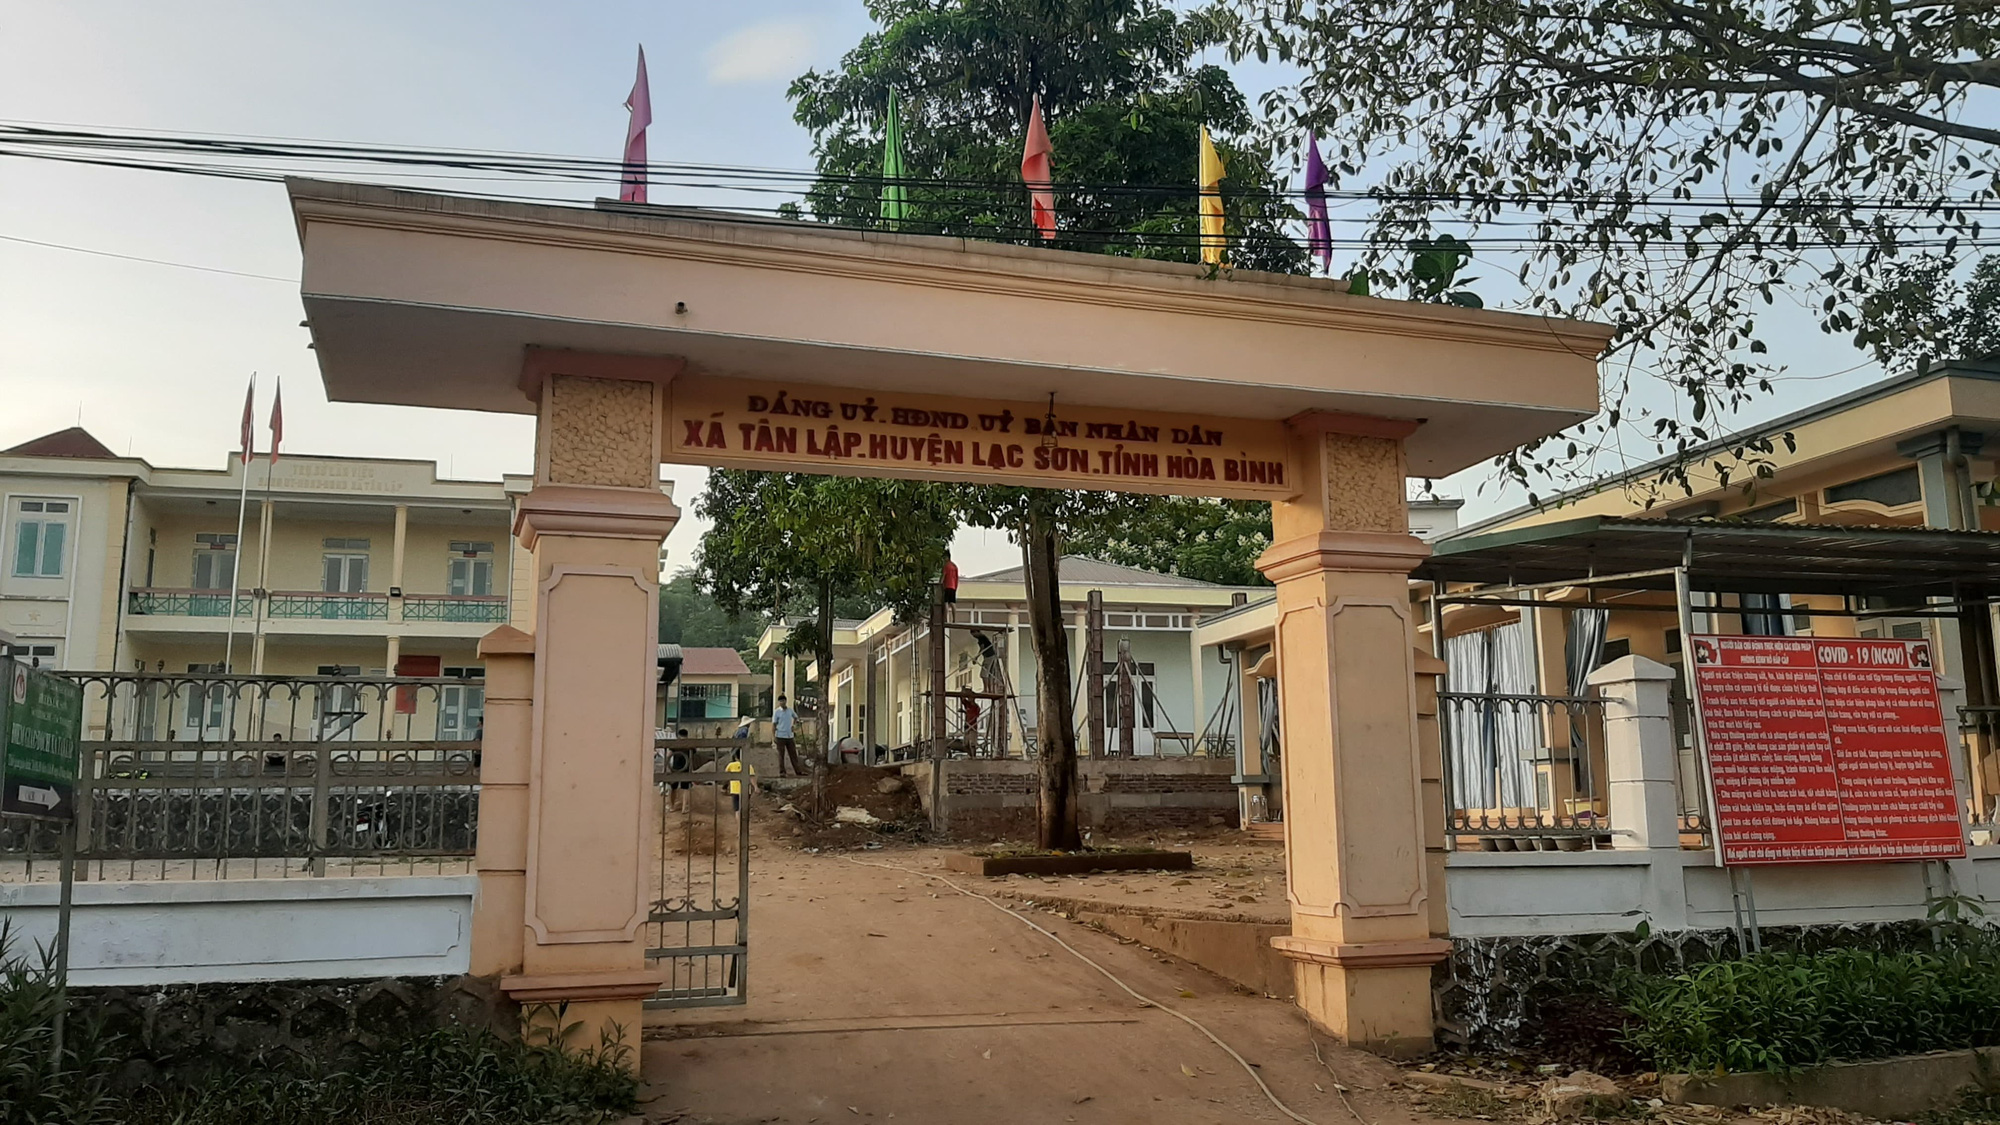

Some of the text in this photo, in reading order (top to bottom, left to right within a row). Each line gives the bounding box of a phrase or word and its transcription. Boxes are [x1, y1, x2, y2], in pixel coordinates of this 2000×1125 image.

[748, 390, 833, 418] ĐẢNG
[1085, 420, 1159, 442] NHÂN
[1171, 425, 1223, 446] DÂN
[739, 418, 797, 454] TÂN
[972, 441, 1024, 470] LẠC
[1166, 449, 1216, 480] HÒA
[1224, 452, 1283, 484] BÌNH
[1818, 646, 1848, 664] COVID
[1857, 647, 1869, 664] 19
[1871, 645, 1904, 666] (NCOV)
